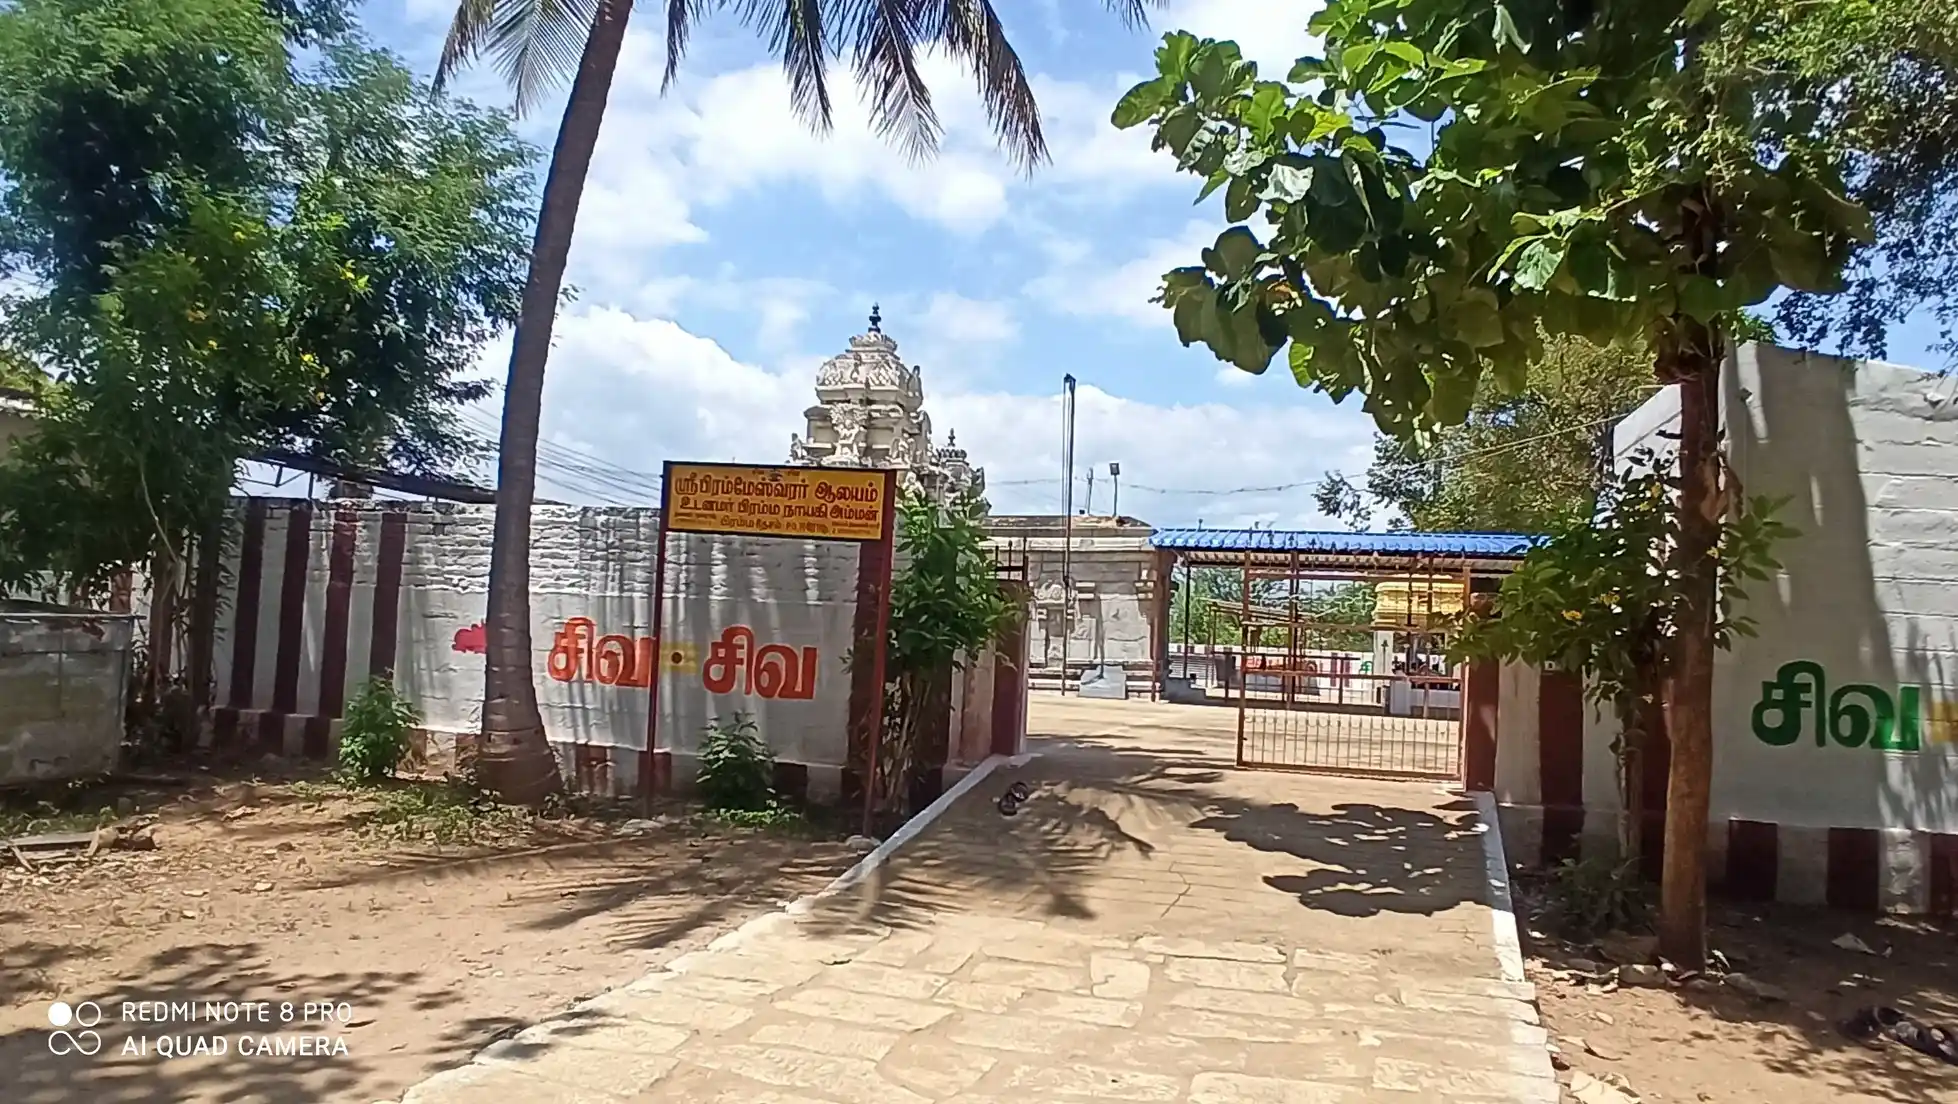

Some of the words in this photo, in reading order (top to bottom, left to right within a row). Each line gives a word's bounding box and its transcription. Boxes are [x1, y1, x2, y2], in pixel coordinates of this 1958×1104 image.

[738, 498, 780, 516] பிரம்ம
[783, 503, 828, 518] நாயகி
[830, 504, 879, 521] அம்மன்
[815, 480, 879, 503] ஆலயம்
[547, 616, 656, 688] சிவ
[703, 624, 818, 700] சிவ
[1751, 660, 1921, 751] சிவ
